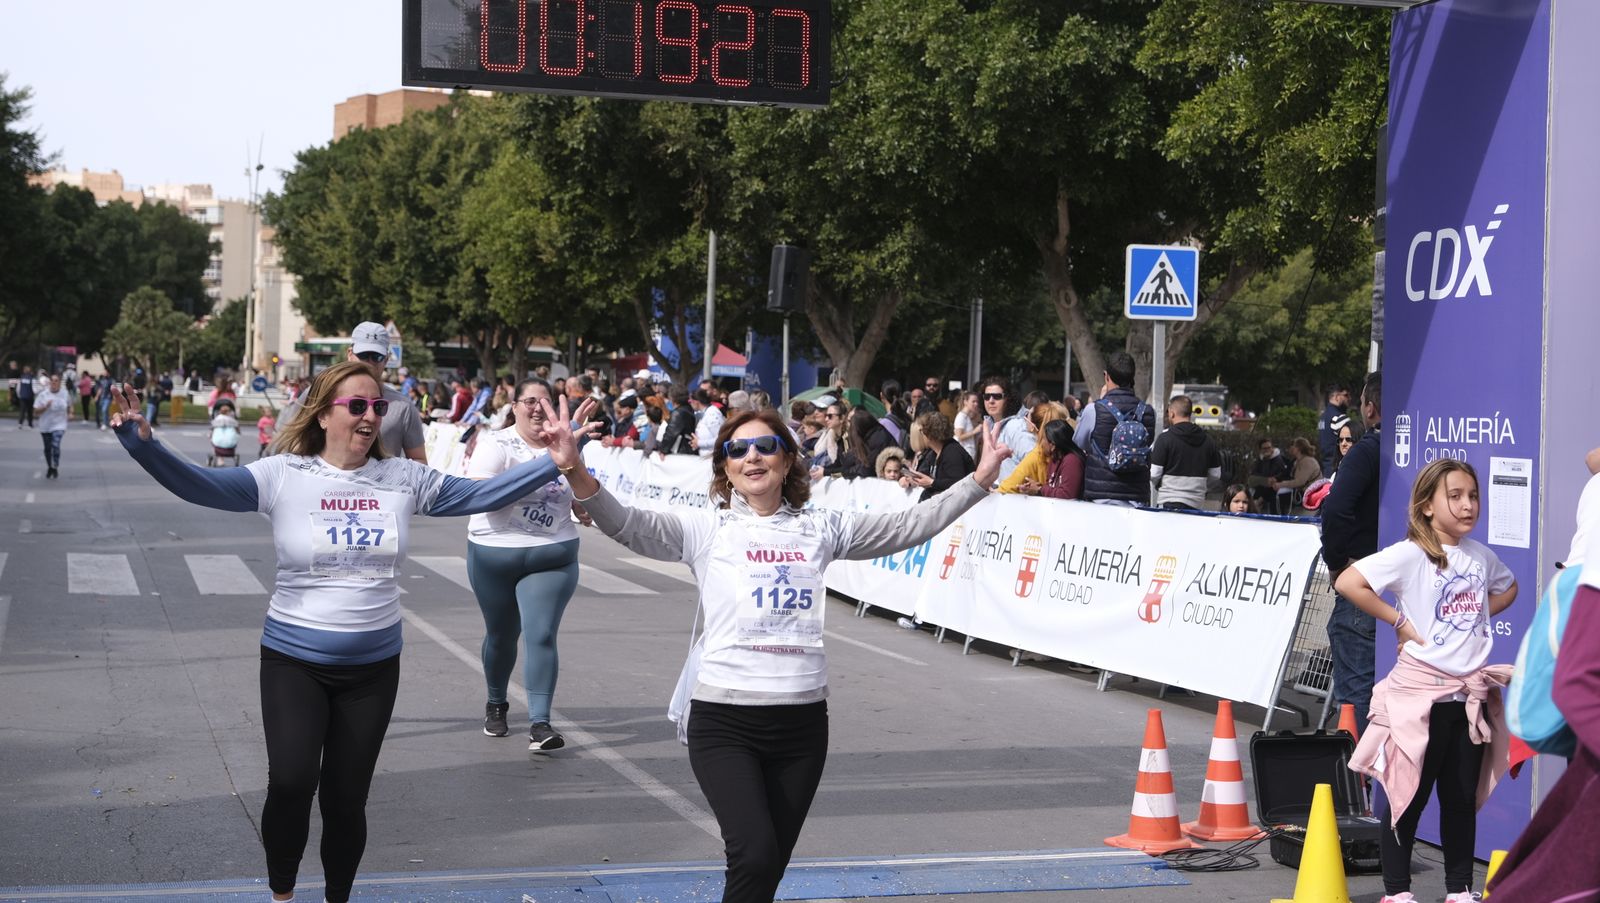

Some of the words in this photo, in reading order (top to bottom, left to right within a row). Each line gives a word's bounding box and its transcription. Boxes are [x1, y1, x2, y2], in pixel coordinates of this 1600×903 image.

[1405, 225, 1495, 302] CDX
[1425, 412, 1515, 444] ALMERÍA
[1424, 447, 1467, 463] CIUDAD
[321, 499, 380, 511] MUJER
[522, 506, 553, 527] 1040
[326, 527, 385, 546] 1127
[746, 550, 807, 563] MUJER
[1054, 543, 1142, 586] ALMERÍA
[1049, 579, 1093, 605] CIUDAD
[1186, 562, 1292, 606] ALMERÍA
[751, 587, 813, 610] 1125
[1453, 592, 1477, 603] MINI
[1182, 601, 1234, 628] CIUDAD
[1442, 602, 1483, 616] RUNNE
[1492, 621, 1512, 636] .es
